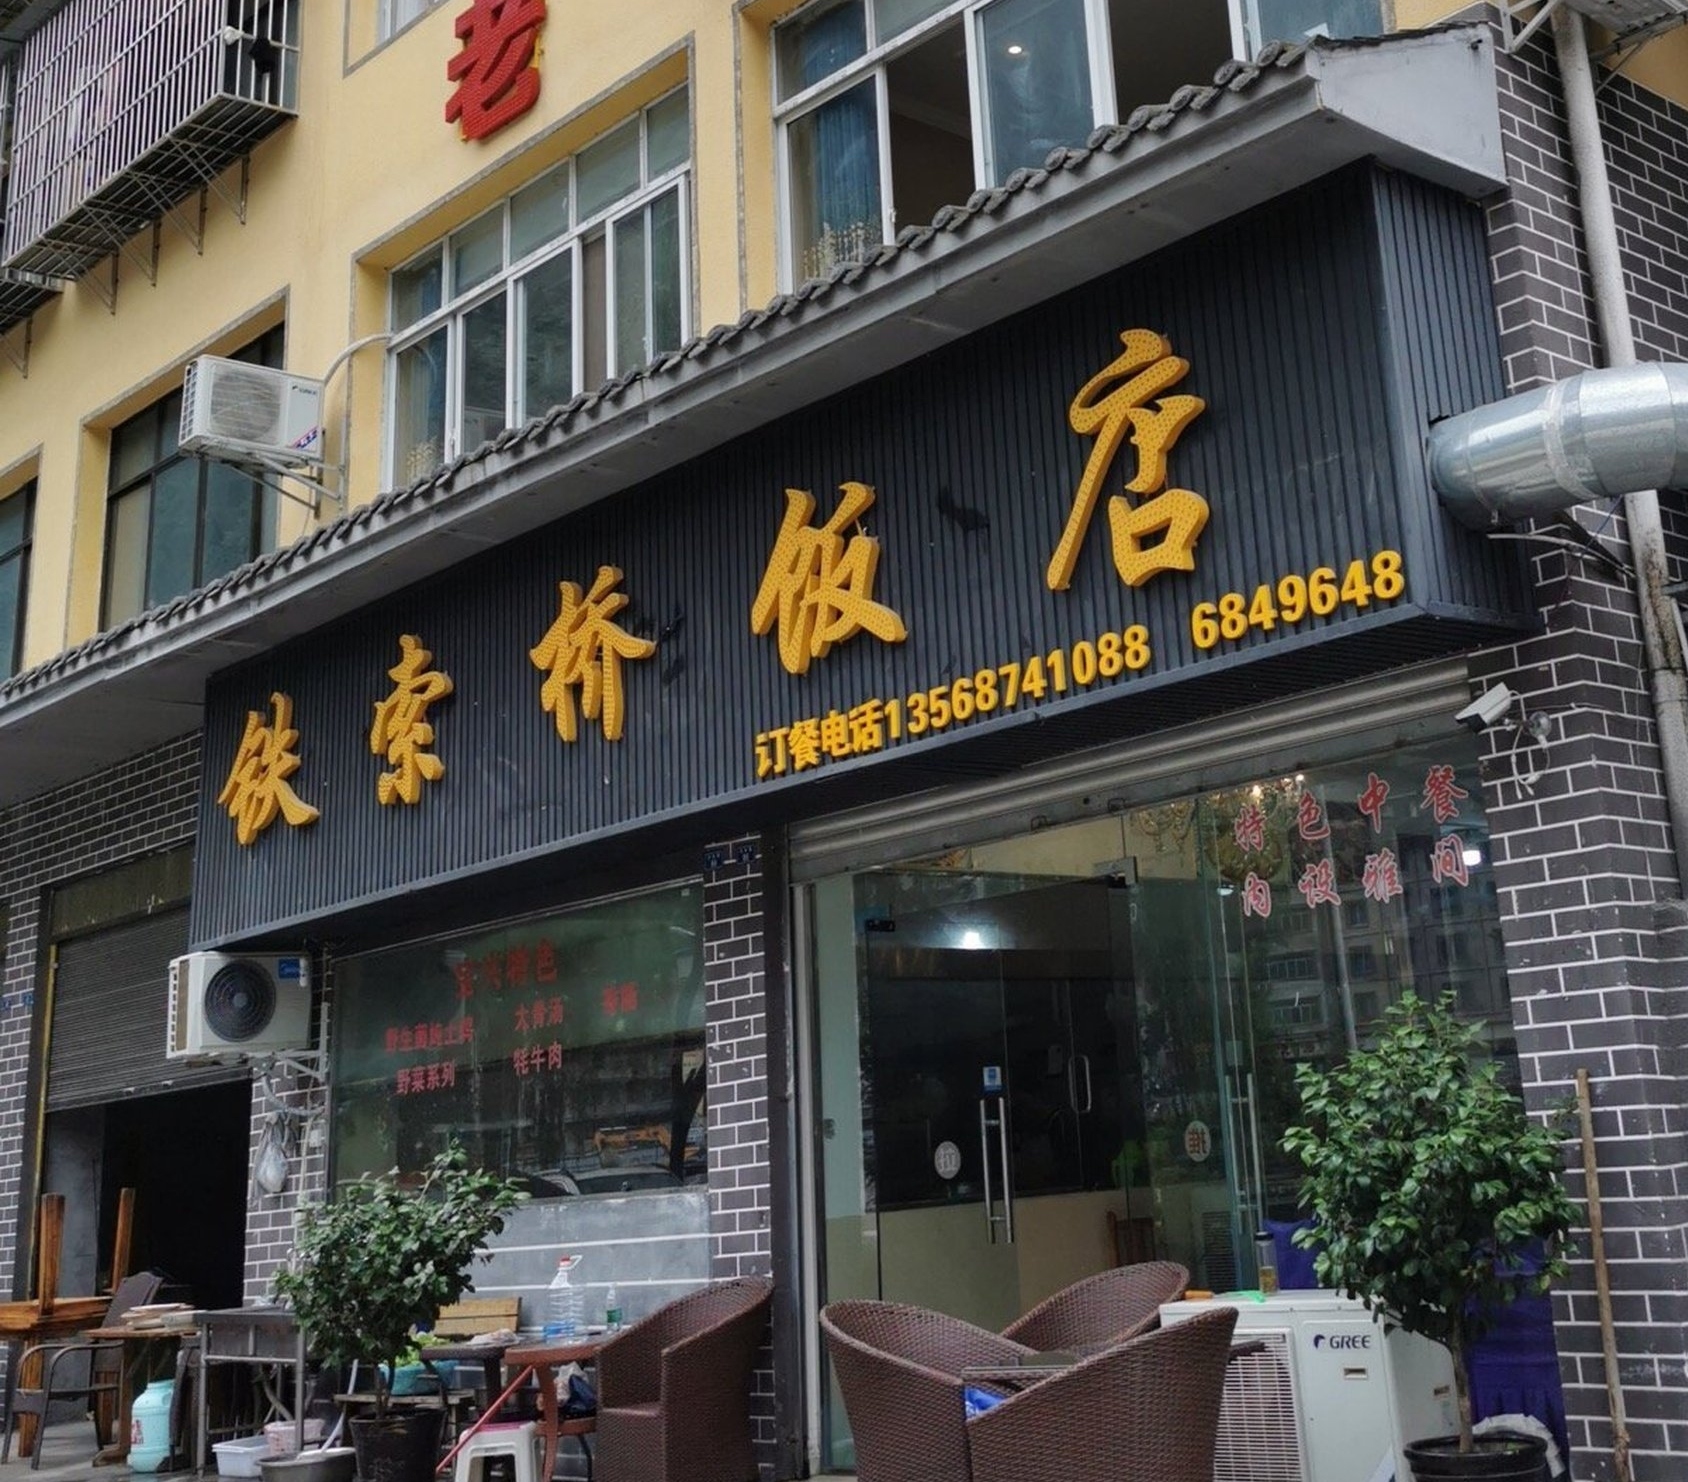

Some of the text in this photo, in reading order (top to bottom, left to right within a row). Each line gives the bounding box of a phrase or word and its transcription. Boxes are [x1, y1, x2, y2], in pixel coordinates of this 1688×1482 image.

[445, 0, 547, 142] 老
[218, 328, 1209, 845] 铁索桥饭店
[1191, 550, 1403, 648] 6849648
[1234, 765, 1468, 851] 特色中餐
[1241, 834, 1469, 918] 内设雅间
[395, 1059, 456, 1096] 野菜系列
[512, 1041, 563, 1077] 牦牛肉
[1329, 1334, 1372, 1350] GREE
